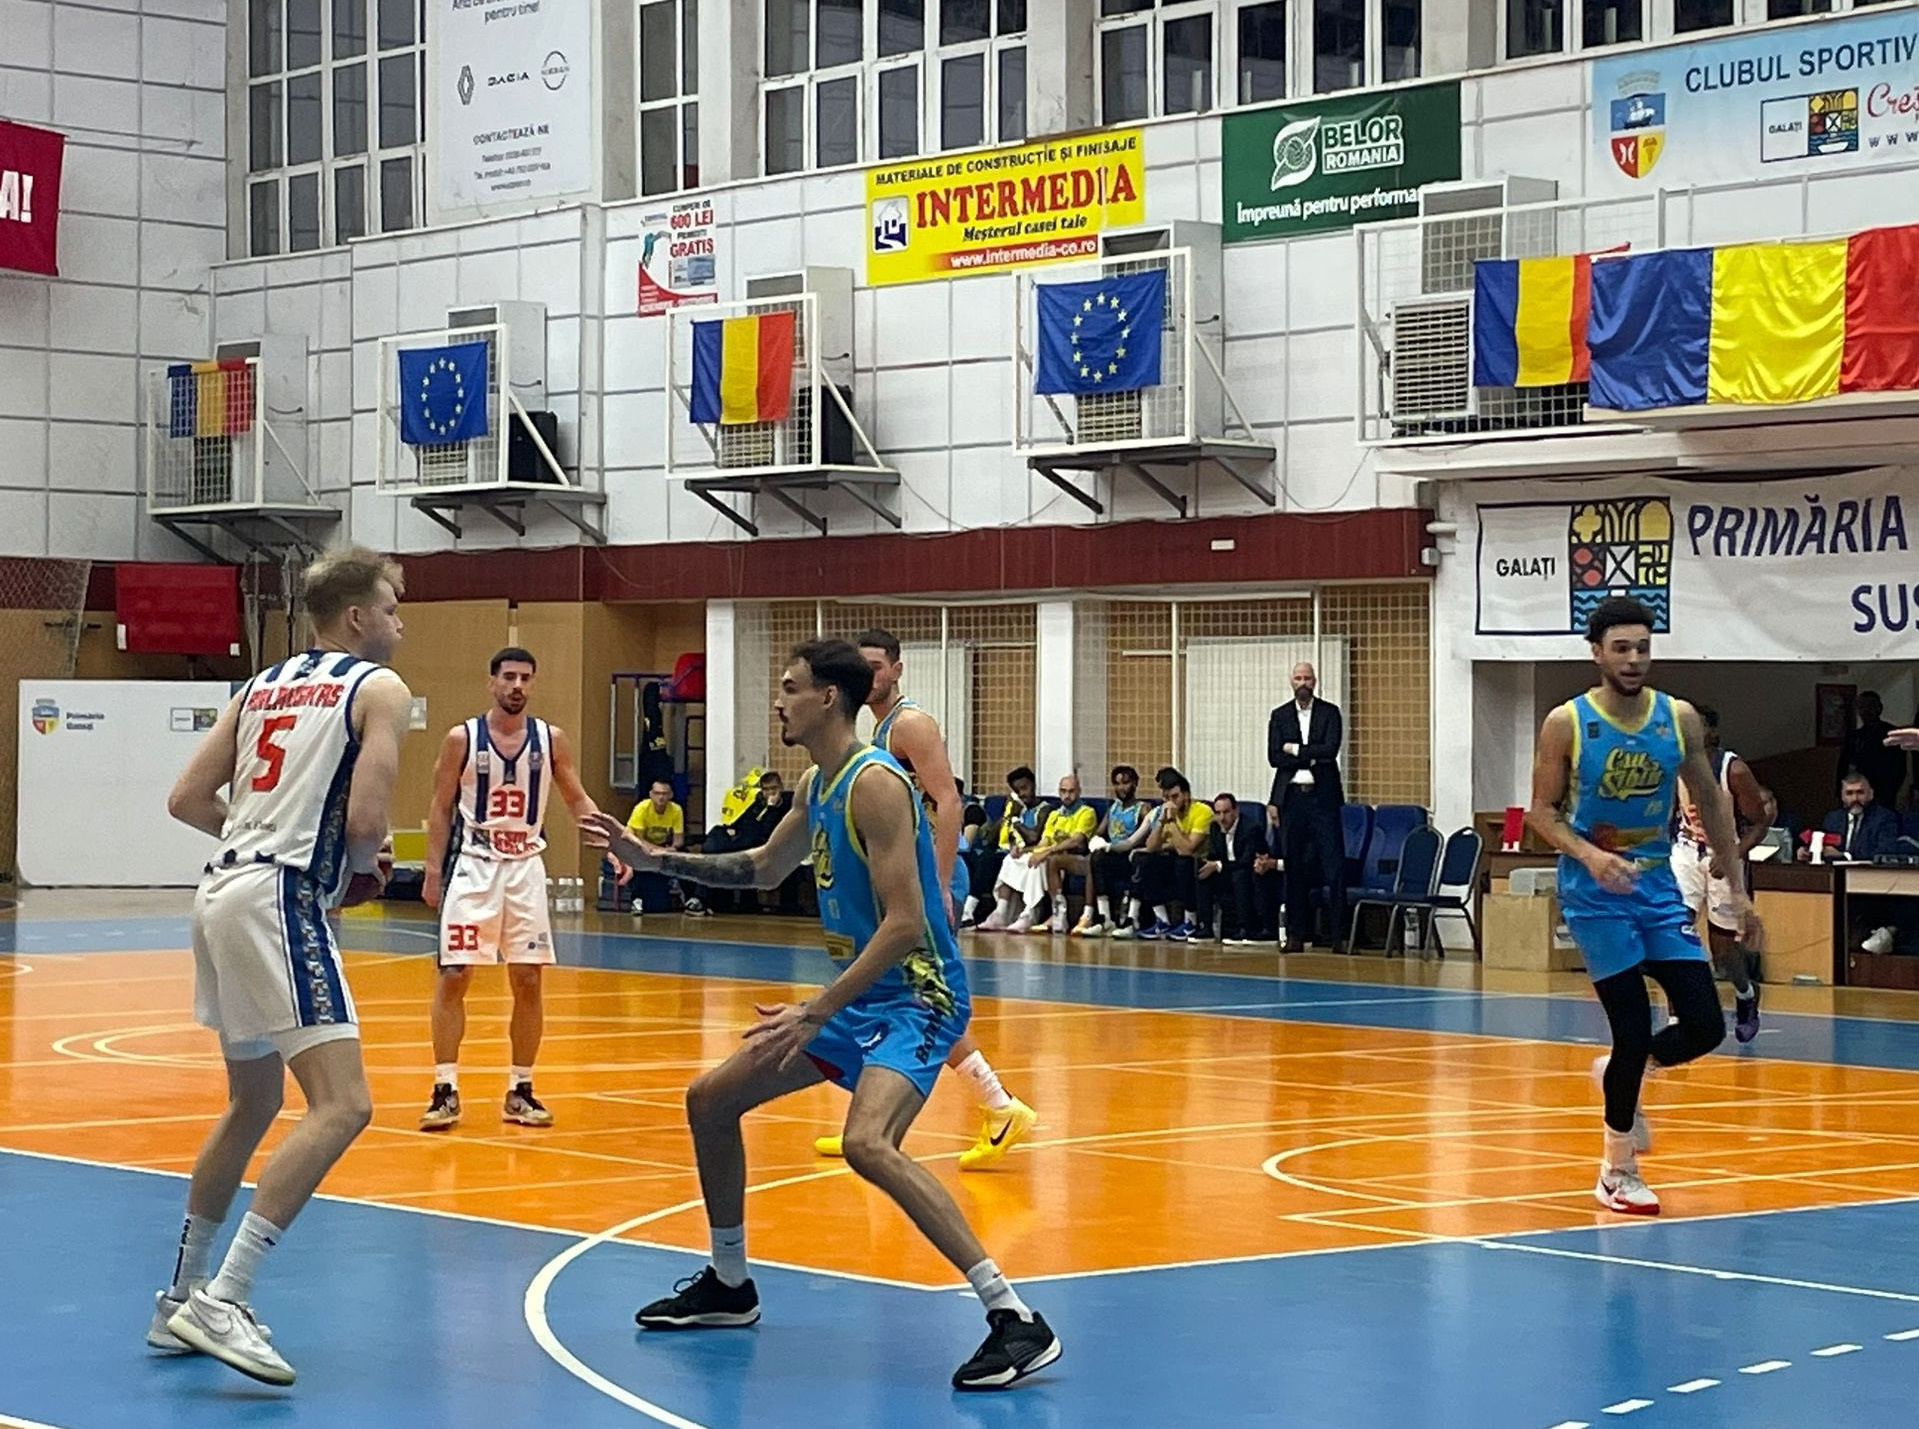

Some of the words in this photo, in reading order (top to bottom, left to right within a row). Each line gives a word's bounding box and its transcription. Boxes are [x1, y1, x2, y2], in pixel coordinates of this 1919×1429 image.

[1685, 55, 1790, 93] CLUBUL
[1799, 33, 1918, 76] SPORTIV
[488, 72, 529, 86] DACIA
[1323, 116, 1403, 149] BELOR
[876, 166, 943, 185] MATERIALE
[947, 163, 963, 176] DE
[1077, 137, 1136, 159] FINISAJE
[1325, 146, 1399, 169] ROMANIA
[916, 164, 1137, 228] INTERMEDIA
[671, 212, 691, 230] 600
[695, 209, 713, 227] LEI
[1236, 199, 1301, 226] Împreună
[1303, 195, 1349, 220] pentru
[962, 221, 1021, 242] Meșterul
[1025, 216, 1057, 234] casei
[1061, 214, 1087, 229] tale
[670, 238, 714, 258] GRATIS
[951, 239, 1097, 268] www.intermedia-co.ro
[1687, 494, 1909, 557] PRIMĂRIA
[1496, 556, 1556, 581] GALAȚI
[252, 714, 298, 793] 5
[490, 790, 526, 818] 33
[447, 924, 480, 951] 33
